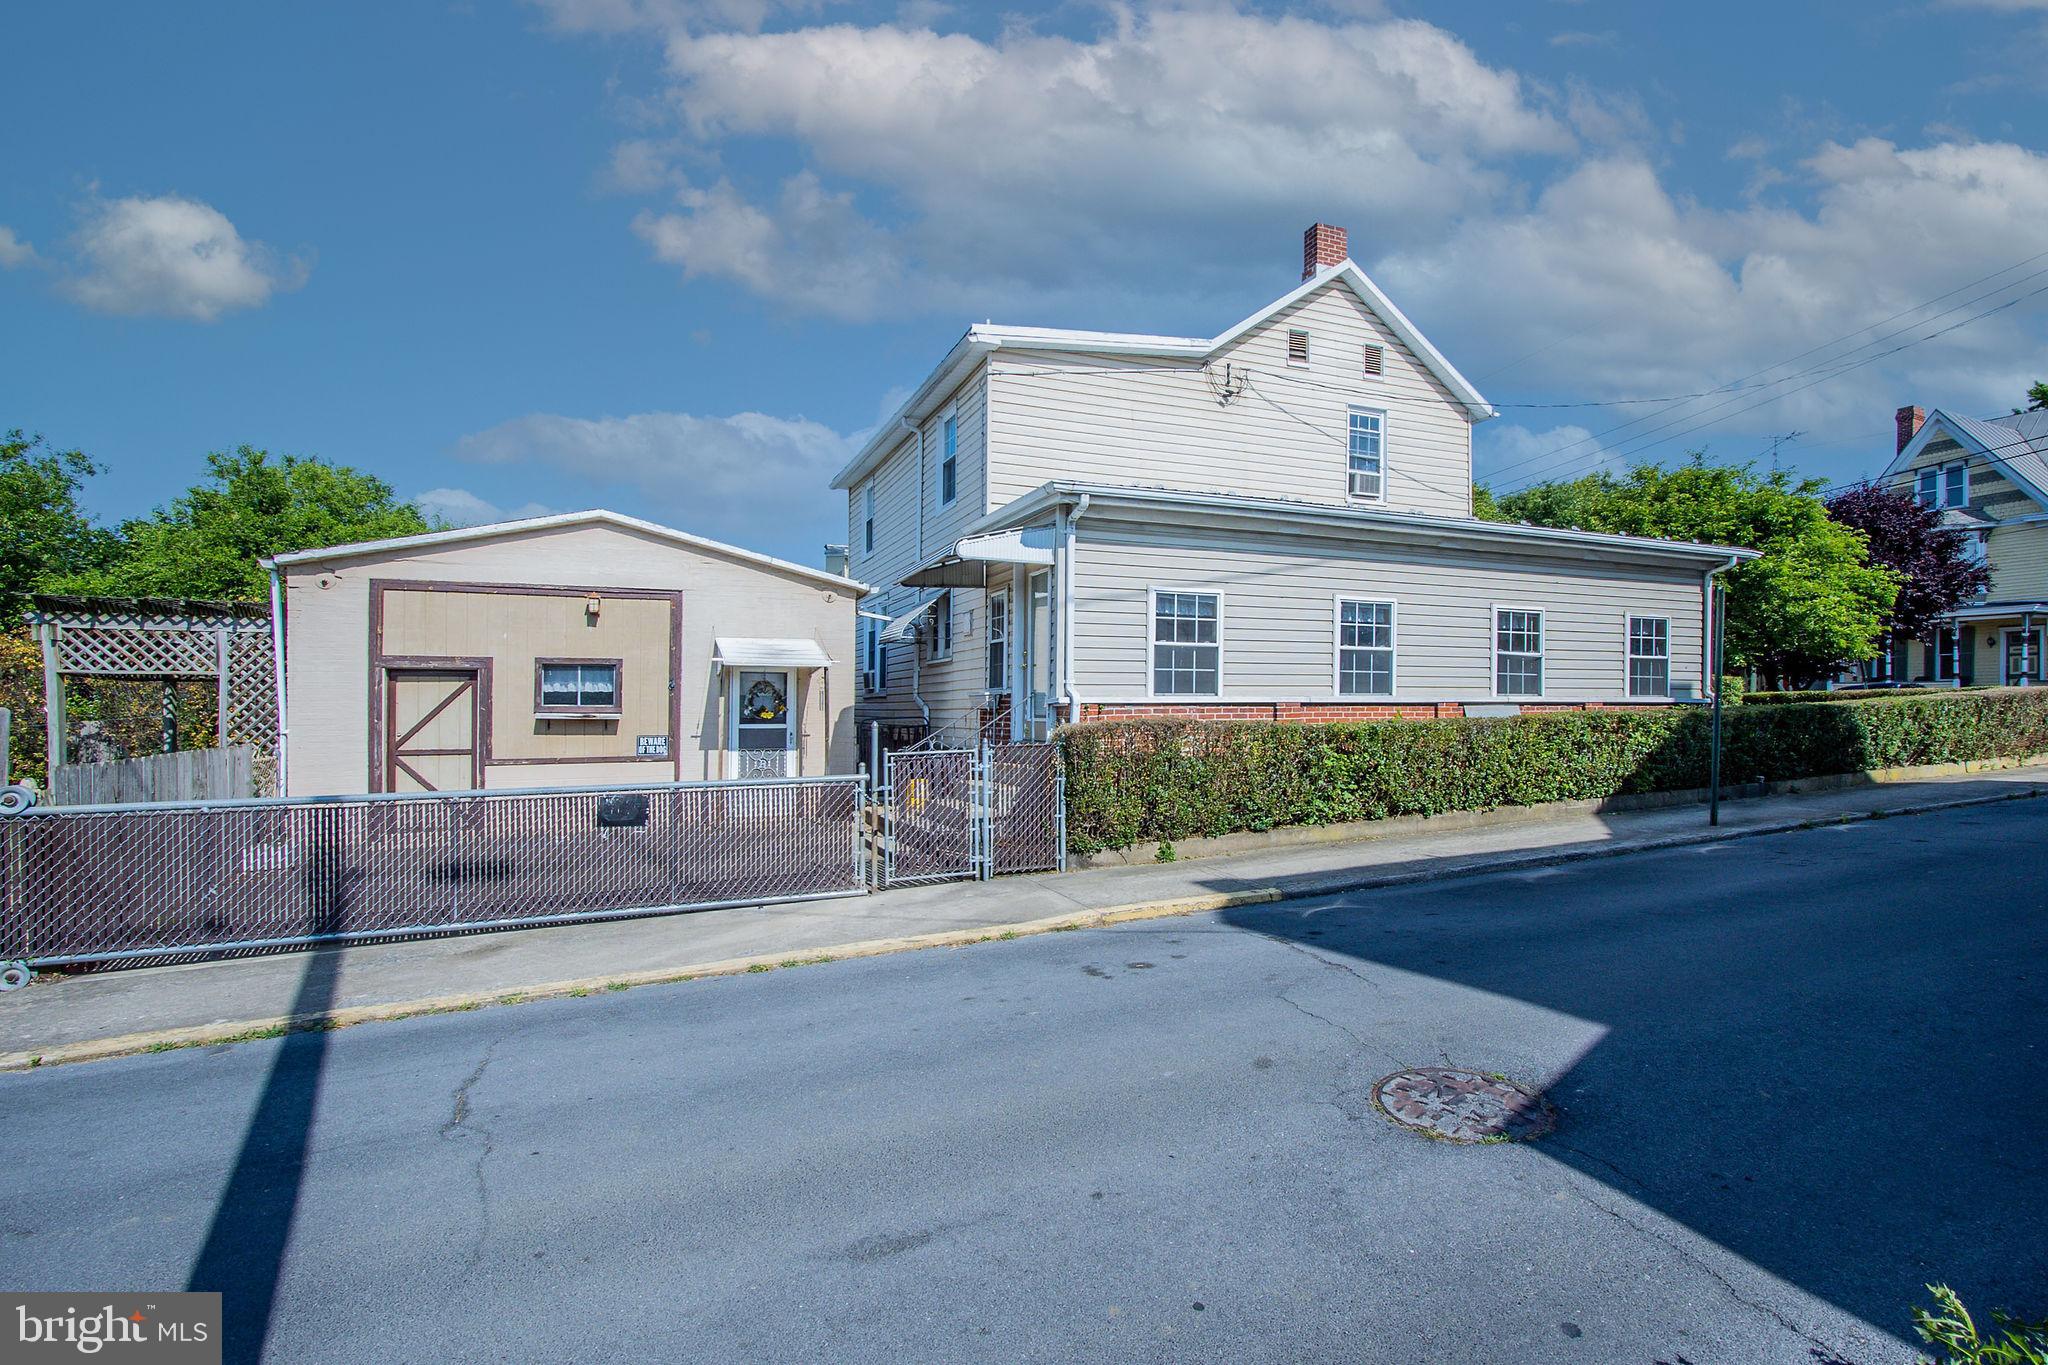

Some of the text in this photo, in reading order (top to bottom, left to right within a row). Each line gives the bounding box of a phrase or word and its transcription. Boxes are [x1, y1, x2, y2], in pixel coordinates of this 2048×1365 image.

[639, 737, 666, 746] BEWARE
[638, 746, 668, 754] OF THE DOG
